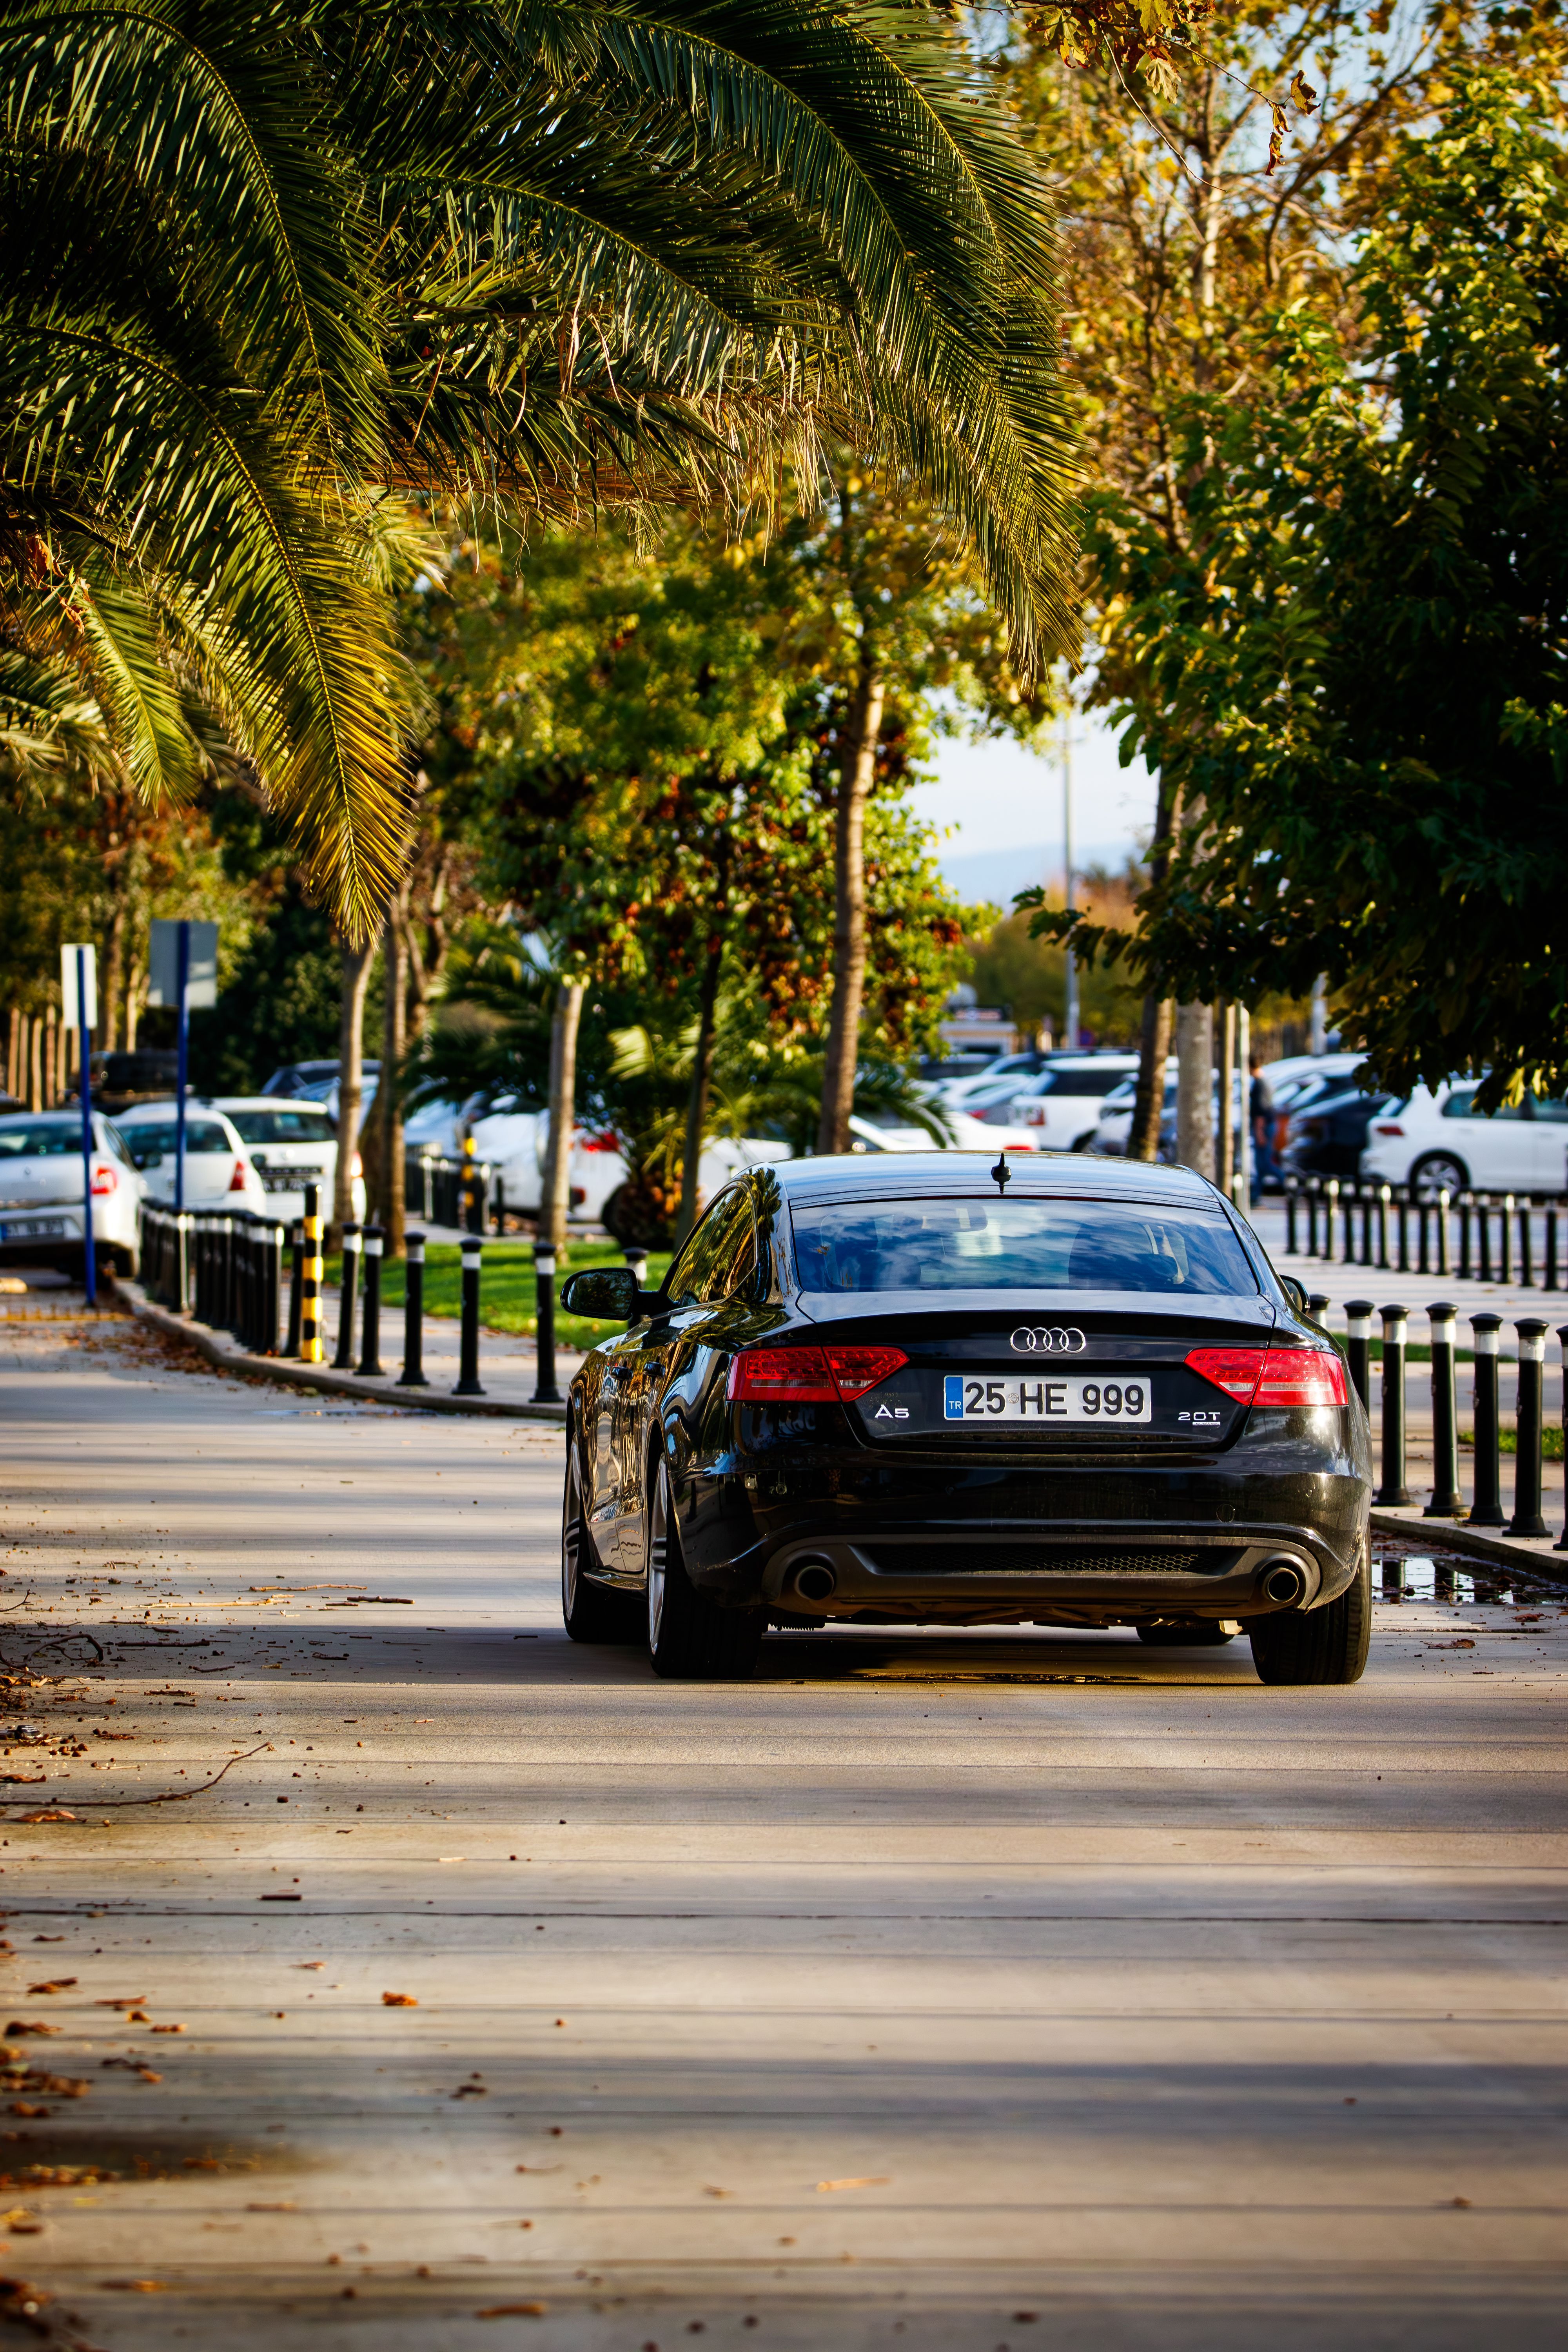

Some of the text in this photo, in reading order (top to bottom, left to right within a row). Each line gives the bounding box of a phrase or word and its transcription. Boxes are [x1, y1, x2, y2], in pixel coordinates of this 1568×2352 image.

[874, 1404, 909, 1418] A5
[948, 1382, 1144, 1416] TR 25 HE 999
